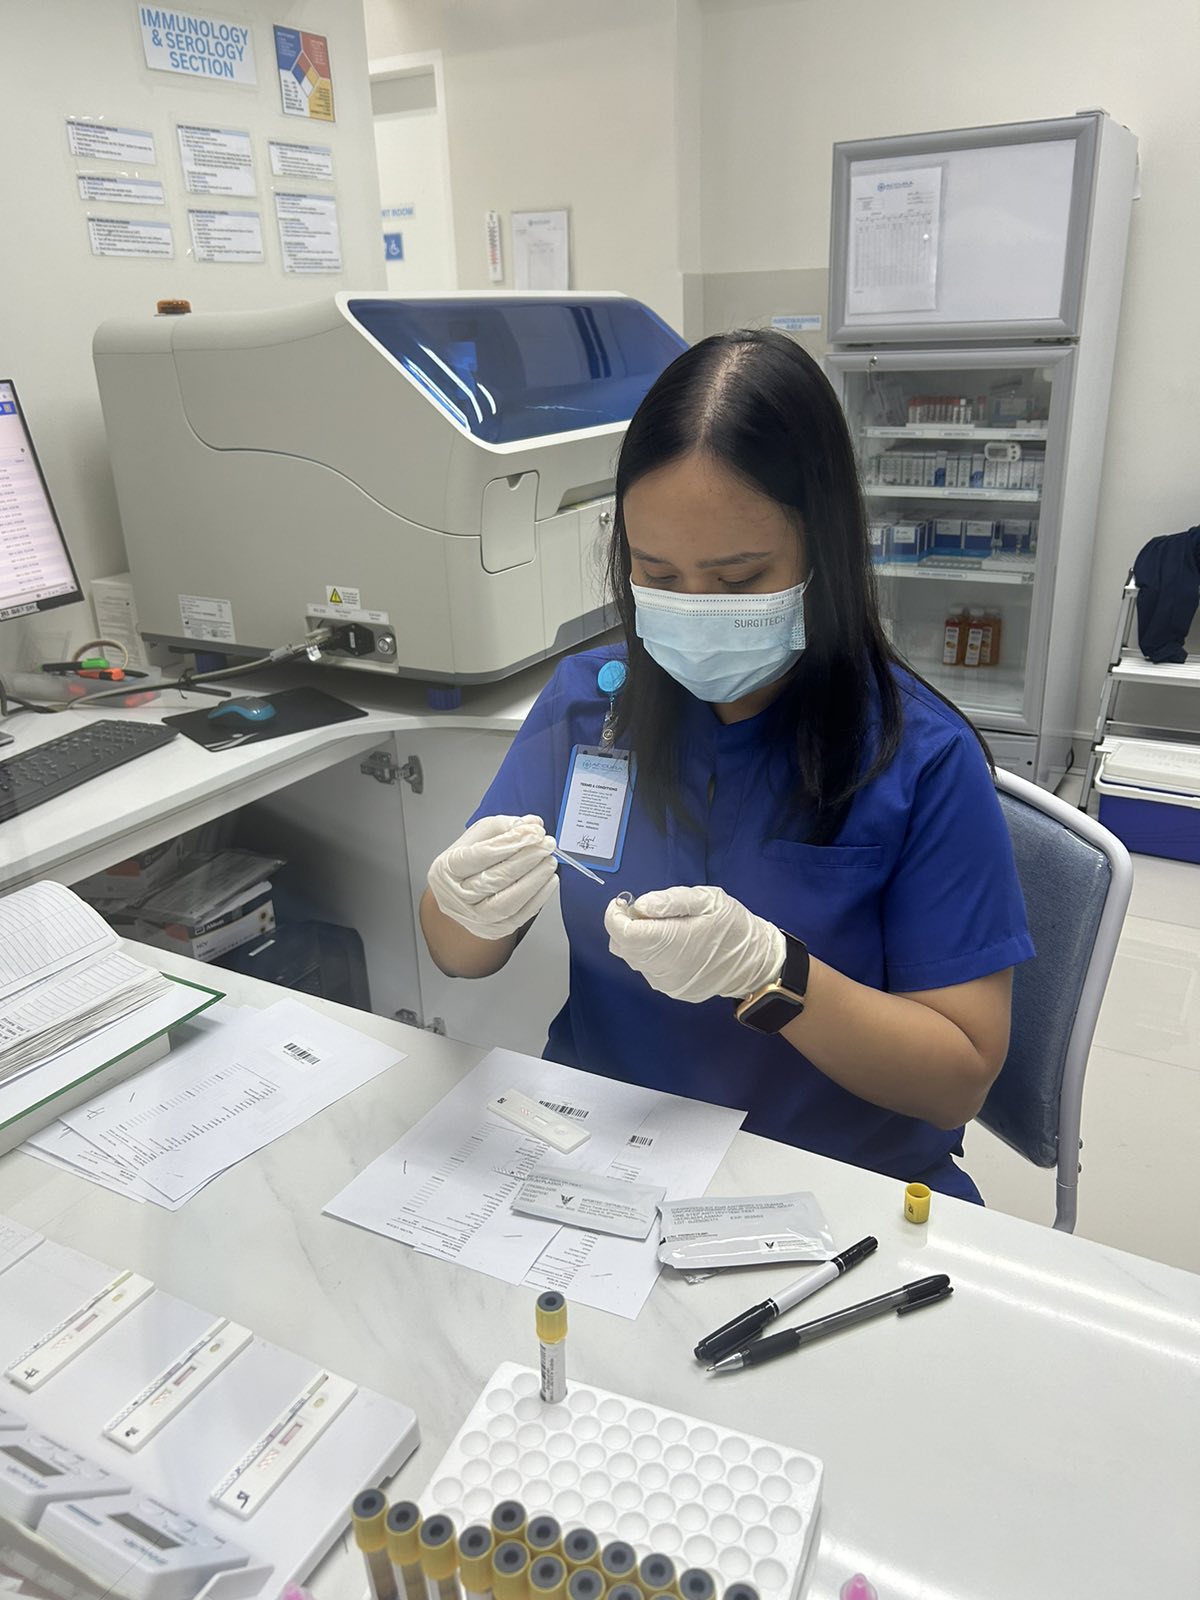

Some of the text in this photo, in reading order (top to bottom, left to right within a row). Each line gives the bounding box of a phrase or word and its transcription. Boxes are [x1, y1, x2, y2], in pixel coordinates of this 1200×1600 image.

[141, 8, 248, 45] IMMUNOLOGY
[152, 29, 244, 62] & SEROLOGY
[169, 51, 234, 78] SECTION
[734, 615, 786, 628] SURGITECH
